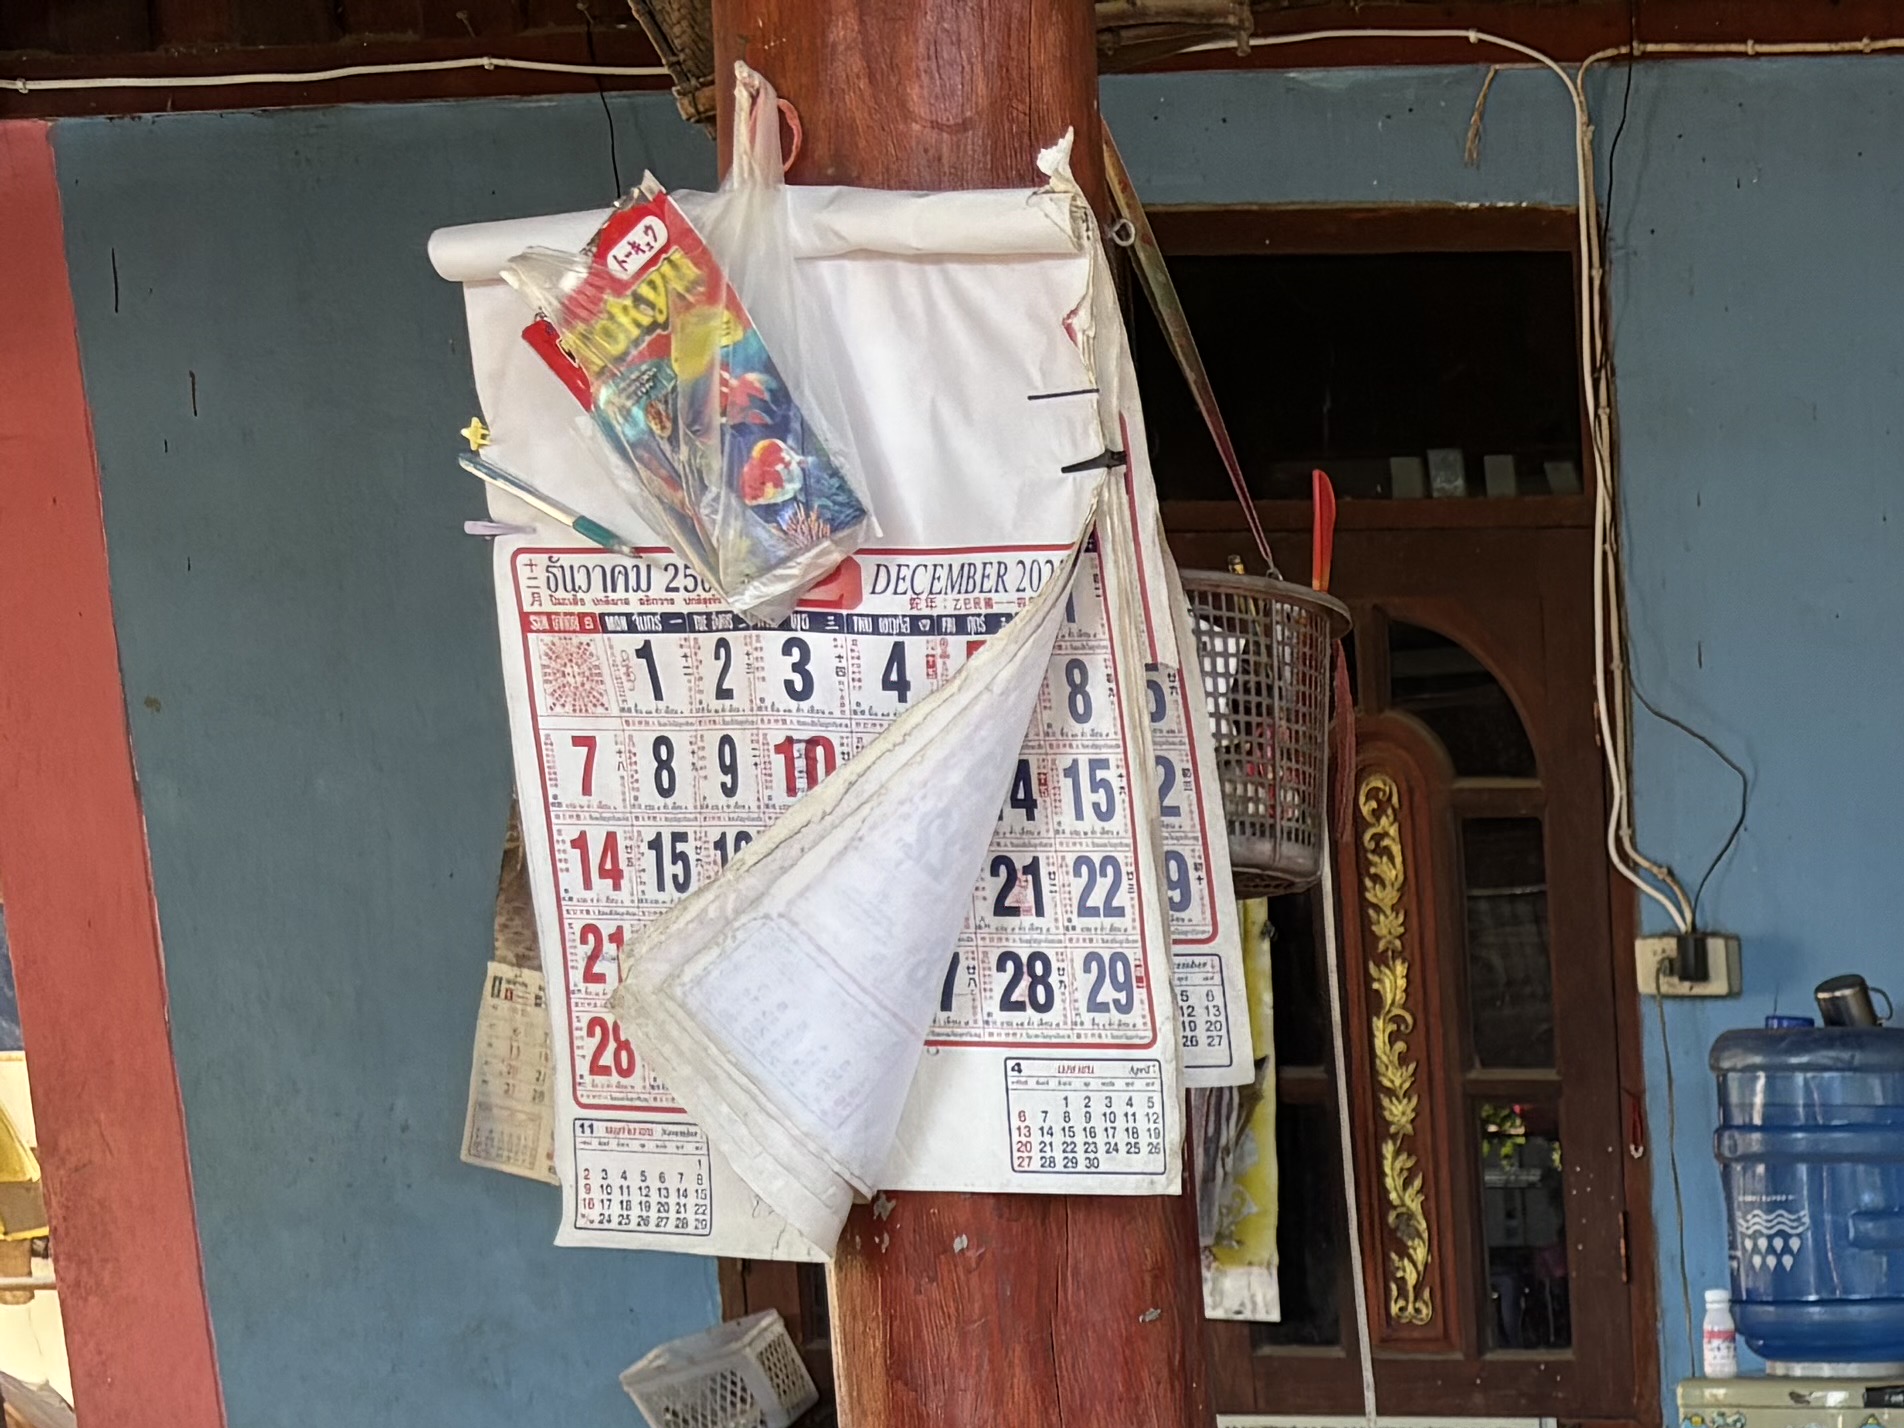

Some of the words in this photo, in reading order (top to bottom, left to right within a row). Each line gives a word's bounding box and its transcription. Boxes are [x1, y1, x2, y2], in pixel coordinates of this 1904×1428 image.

[546, 555, 651, 593] ธันวาคม
[663, 563, 712, 593] 25
[870, 560, 1009, 596] DECEMBER
[1016, 559, 1064, 593] 202
[635, 639, 664, 701] 1
[714, 637, 734, 700] 2
[782, 637, 814, 702] 3
[881, 641, 911, 703] 4
[1065, 658, 1093, 724] 8
[571, 735, 597, 796] 7
[652, 735, 676, 798] 8
[718, 734, 739, 797] 9
[774, 735, 837, 797] 10
[999, 759, 1038, 821] 4
[1063, 758, 1116, 822] 15
[570, 831, 624, 891] 14
[647, 831, 691, 893] 15
[990, 855, 1044, 918] 21
[1073, 855, 1126, 918] 22
[996, 951, 1054, 1013] 28
[1083, 951, 1133, 1014] 29
[1205, 1005, 1221, 1017] 13
[1205, 1020, 1222, 1032] 20
[586, 1016, 636, 1078] 28
[1182, 1035, 1198, 1047] 26
[1207, 1035, 1223, 1047] 27
[1011, 1062, 1023, 1074] 4
[1063, 1096, 1069, 1108] 1
[1084, 1096, 1091, 1108] 2
[1105, 1096, 1112, 1108] 3
[1126, 1096, 1133, 1108] 4
[1147, 1096, 1154, 1108] 5
[1019, 1111, 1026, 1122] 6
[1041, 1111, 1049, 1122] 7
[1063, 1111, 1071, 1123] 8
[1085, 1111, 1091, 1124] 9
[1102, 1112, 1116, 1124] 10
[1124, 1112, 1136, 1124] 11
[1145, 1112, 1159, 1124] 12
[579, 1122, 594, 1135] 11
[1017, 1126, 1031, 1138] 13
[1039, 1126, 1053, 1138] 14
[1062, 1126, 1075, 1138] 15
[1083, 1126, 1096, 1139] 16
[1104, 1127, 1117, 1139] 17
[1125, 1127, 1139, 1139] 18
[1147, 1127, 1160, 1139] 19
[1017, 1141, 1032, 1153] 20
[1039, 1141, 1053, 1153] 21
[1062, 1142, 1077, 1154] 22
[1084, 1142, 1098, 1154] 23
[1105, 1142, 1119, 1154] 24
[1126, 1142, 1140, 1154] 25
[1147, 1142, 1160, 1155] 26
[698, 1159, 701, 1170] 1
[1017, 1156, 1032, 1168] 27
[1040, 1156, 1056, 1169] 28
[1063, 1156, 1078, 1169] 29
[1085, 1156, 1099, 1169] 30
[584, 1168, 590, 1180] 2
[601, 1169, 608, 1180] 3
[621, 1170, 627, 1181] 4
[640, 1170, 647, 1182] 5
[659, 1172, 665, 1183] 6
[678, 1173, 684, 1184] 7
[697, 1174, 703, 1185] 8
[584, 1183, 591, 1195] 9
[600, 1184, 612, 1196] 10
[619, 1185, 630, 1196] 11
[638, 1186, 650, 1197] 12
[658, 1187, 669, 1199] 13
[676, 1188, 688, 1199] 14
[695, 1189, 707, 1200] 15
[583, 1198, 594, 1209] 16
[600, 1199, 612, 1211] 17
[620, 1200, 631, 1211] 18
[639, 1201, 650, 1212] 19
[657, 1202, 669, 1213] 20
[676, 1203, 686, 1214] 21
[694, 1204, 707, 1215] 22
[598, 1213, 611, 1224] 24
[618, 1214, 630, 1226] 25
[637, 1216, 650, 1227] 26
[655, 1217, 669, 1228] 27
[675, 1218, 688, 1229] 28
[694, 1219, 707, 1230] 29
